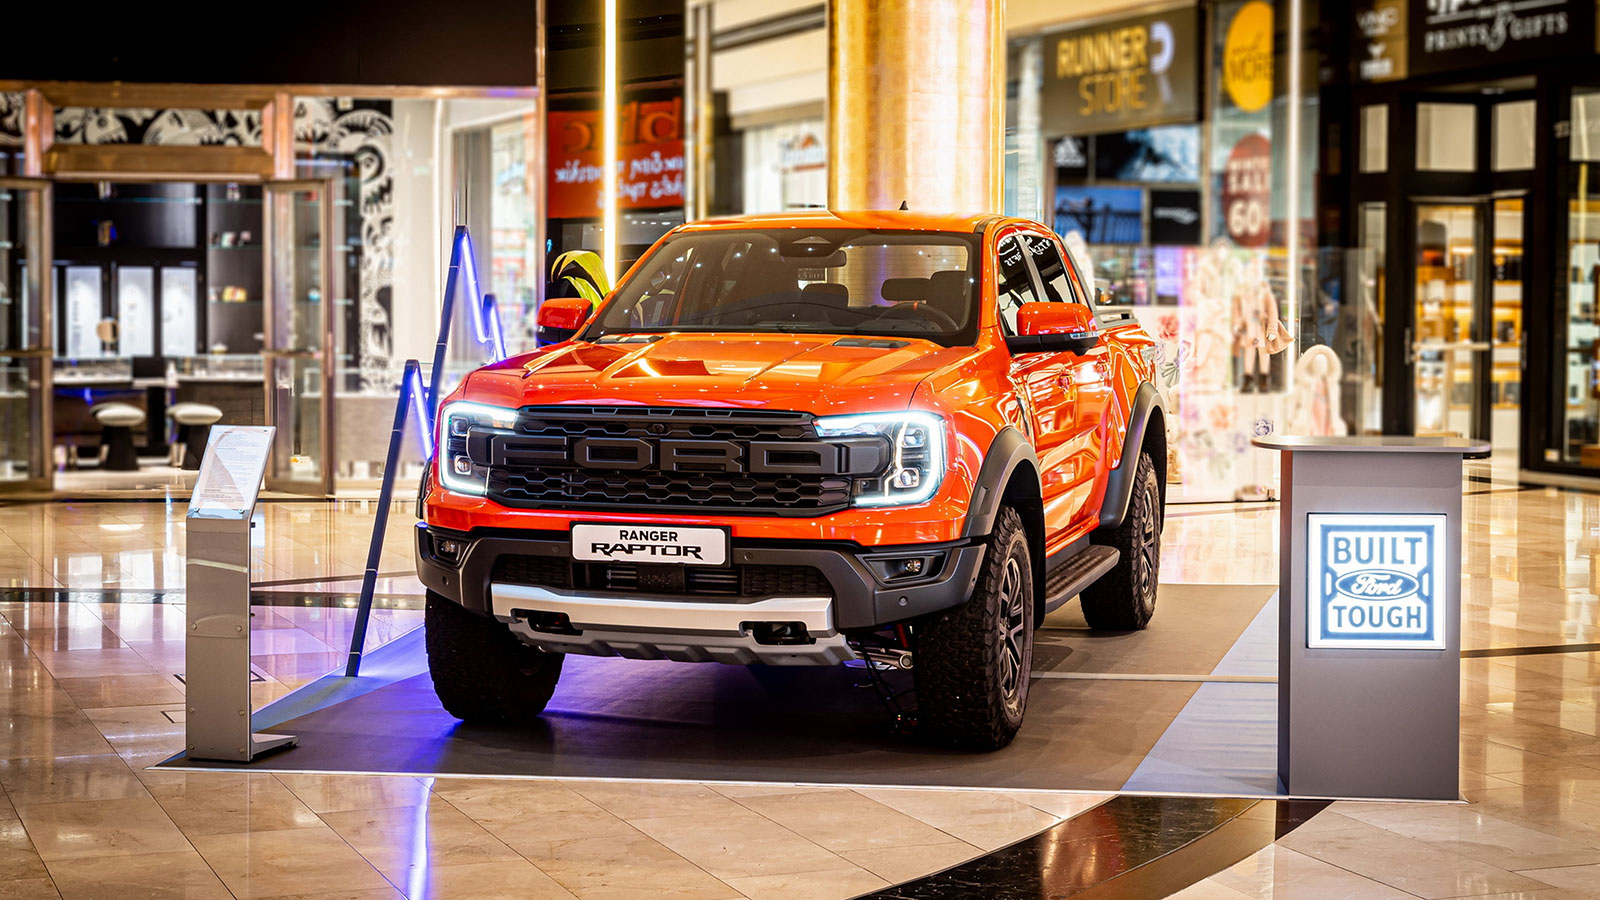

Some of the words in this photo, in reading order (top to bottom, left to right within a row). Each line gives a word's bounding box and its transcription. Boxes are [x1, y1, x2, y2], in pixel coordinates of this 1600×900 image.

[1057, 25, 1148, 78] RUNNER
[1079, 67, 1147, 116] STORE
[1229, 200, 1261, 236] 60
[491, 434, 837, 474] FORD
[619, 530, 678, 542] RANGER
[591, 543, 704, 560] RAPTOR
[1333, 537, 1422, 565] BUILT
[1351, 574, 1403, 595] Ford
[1333, 605, 1421, 628] TOUGH
